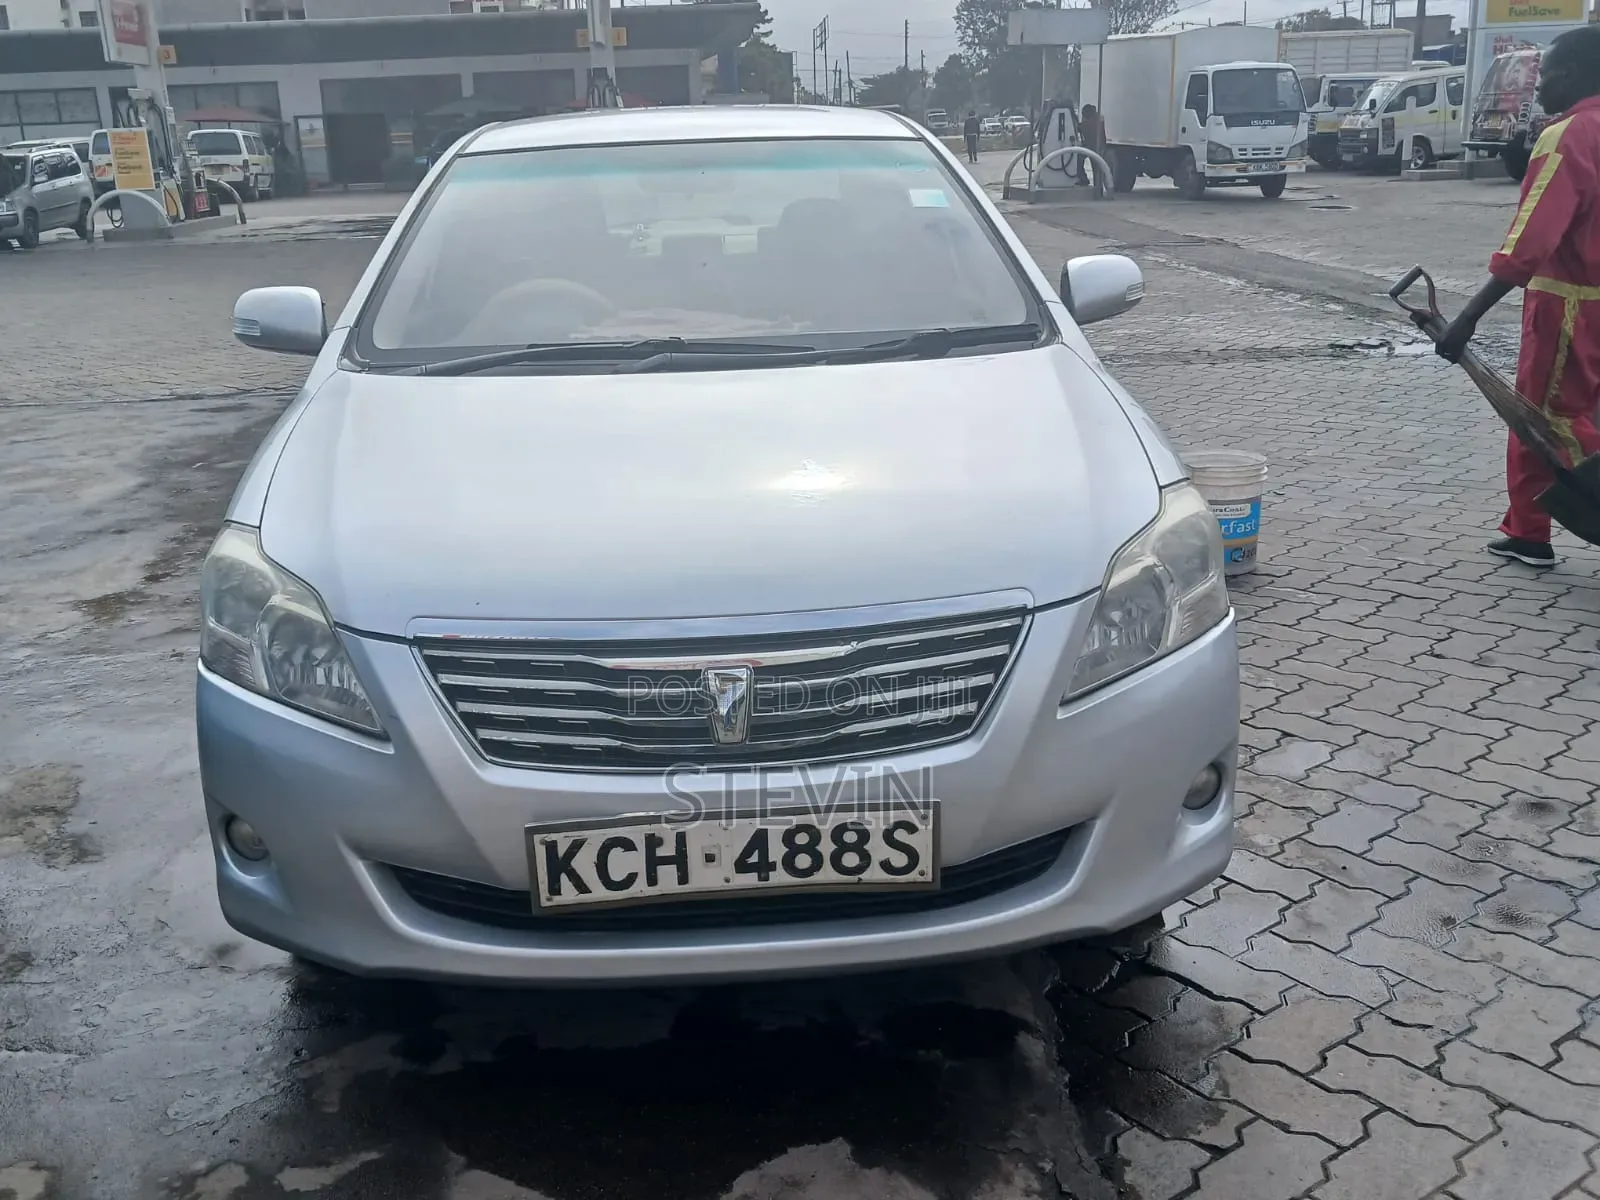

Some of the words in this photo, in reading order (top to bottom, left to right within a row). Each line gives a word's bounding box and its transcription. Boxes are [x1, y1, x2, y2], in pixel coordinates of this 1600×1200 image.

[1509, 5, 1561, 17] FuelSave
[1222, 519, 1256, 533] rfast
[544, 831, 690, 897] KCH
[733, 819, 921, 882] 488S
